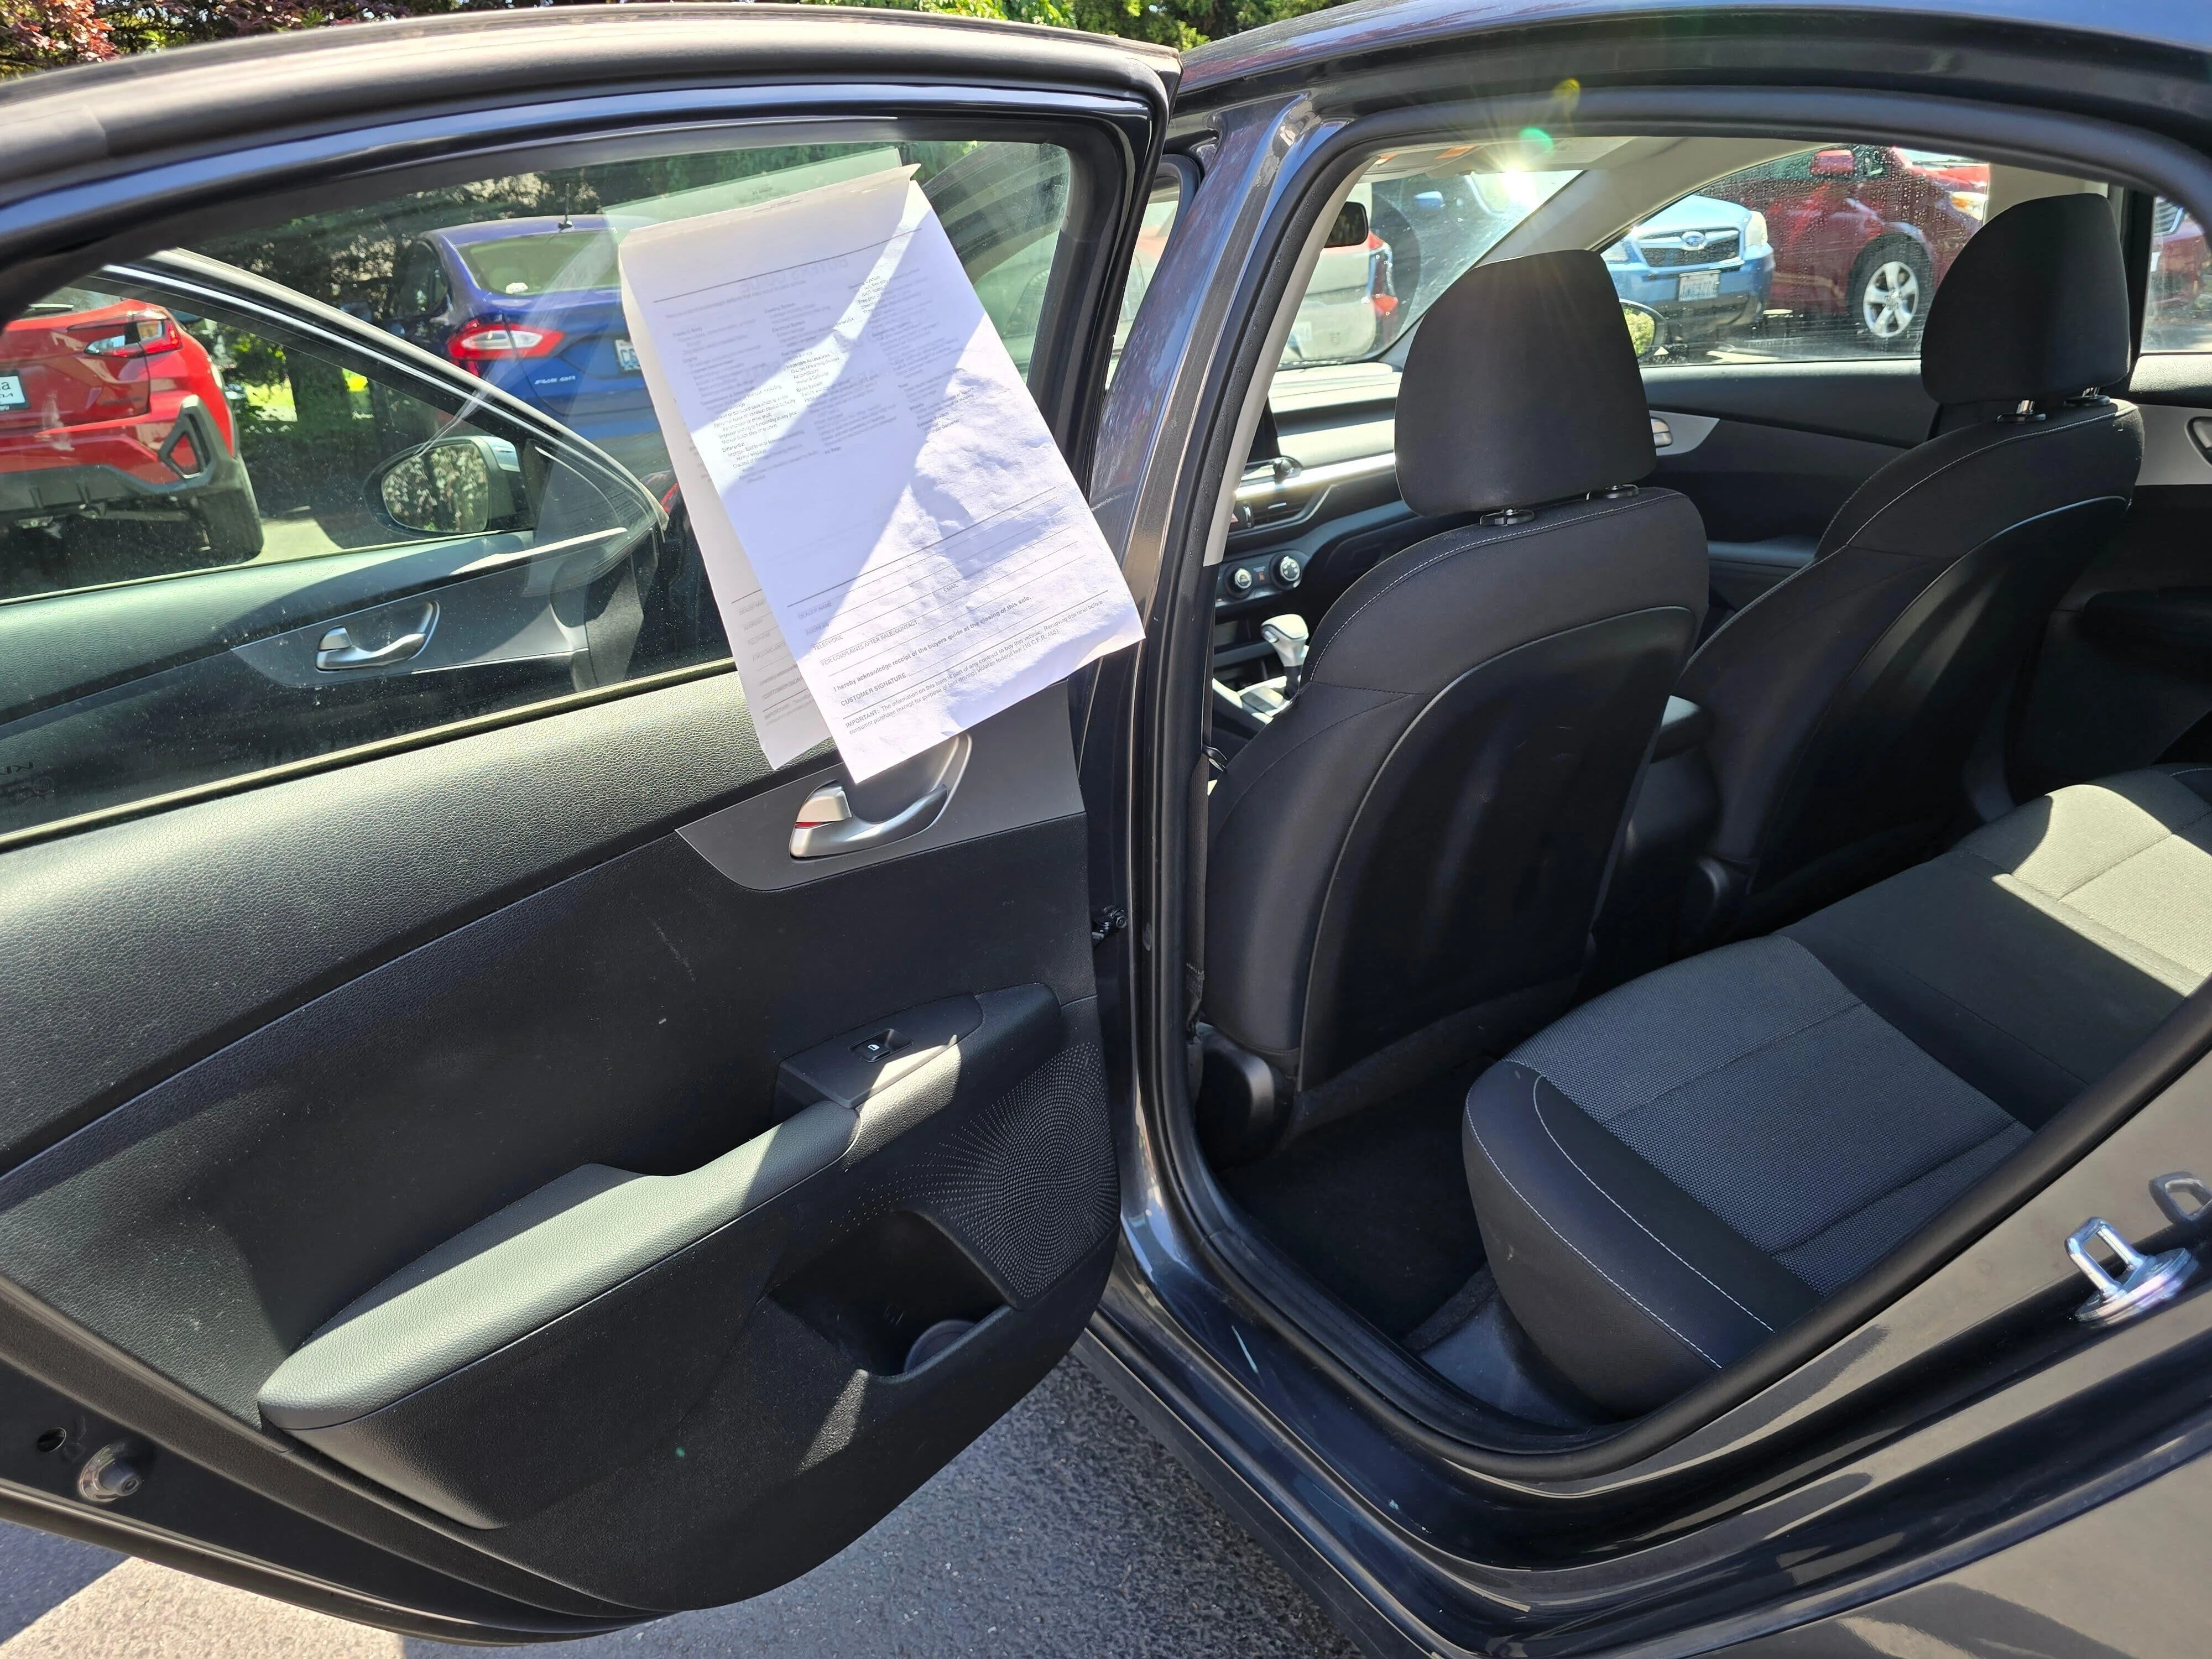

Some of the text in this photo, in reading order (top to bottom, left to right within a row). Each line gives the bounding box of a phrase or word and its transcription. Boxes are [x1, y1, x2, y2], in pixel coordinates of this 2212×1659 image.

[942, 582, 958, 593] EMAIL
[813, 634, 843, 651] TELEPHONE
[821, 658, 833, 666] FOR
[863, 636, 880, 648] AFTER
[836, 677, 857, 691] hereby
[856, 661, 893, 682] acknowledge
[891, 653, 911, 666] receipt
[917, 645, 927, 654] the
[927, 636, 947, 650] buyers
[946, 629, 964, 641] guide
[969, 620, 979, 628] the
[979, 610, 1001, 625] closing
[1006, 601, 1018, 610] this
[1017, 594, 1032, 605] sale.
[845, 708, 880, 728] IMPORTANT:
[880, 702, 891, 711] The
[890, 690, 919, 707] information
[925, 682, 935, 690] this
[935, 676, 947, 686] form
[968, 660, 979, 670] any
[1004, 643, 1015, 652] buy
[1013, 638, 1024, 646] this
[1043, 616, 1068, 632] Removing
[840, 672, 907, 706] CUSTOMER SIGNATURE
[848, 719, 874, 735] consumer
[872, 708, 897, 725] purchase
